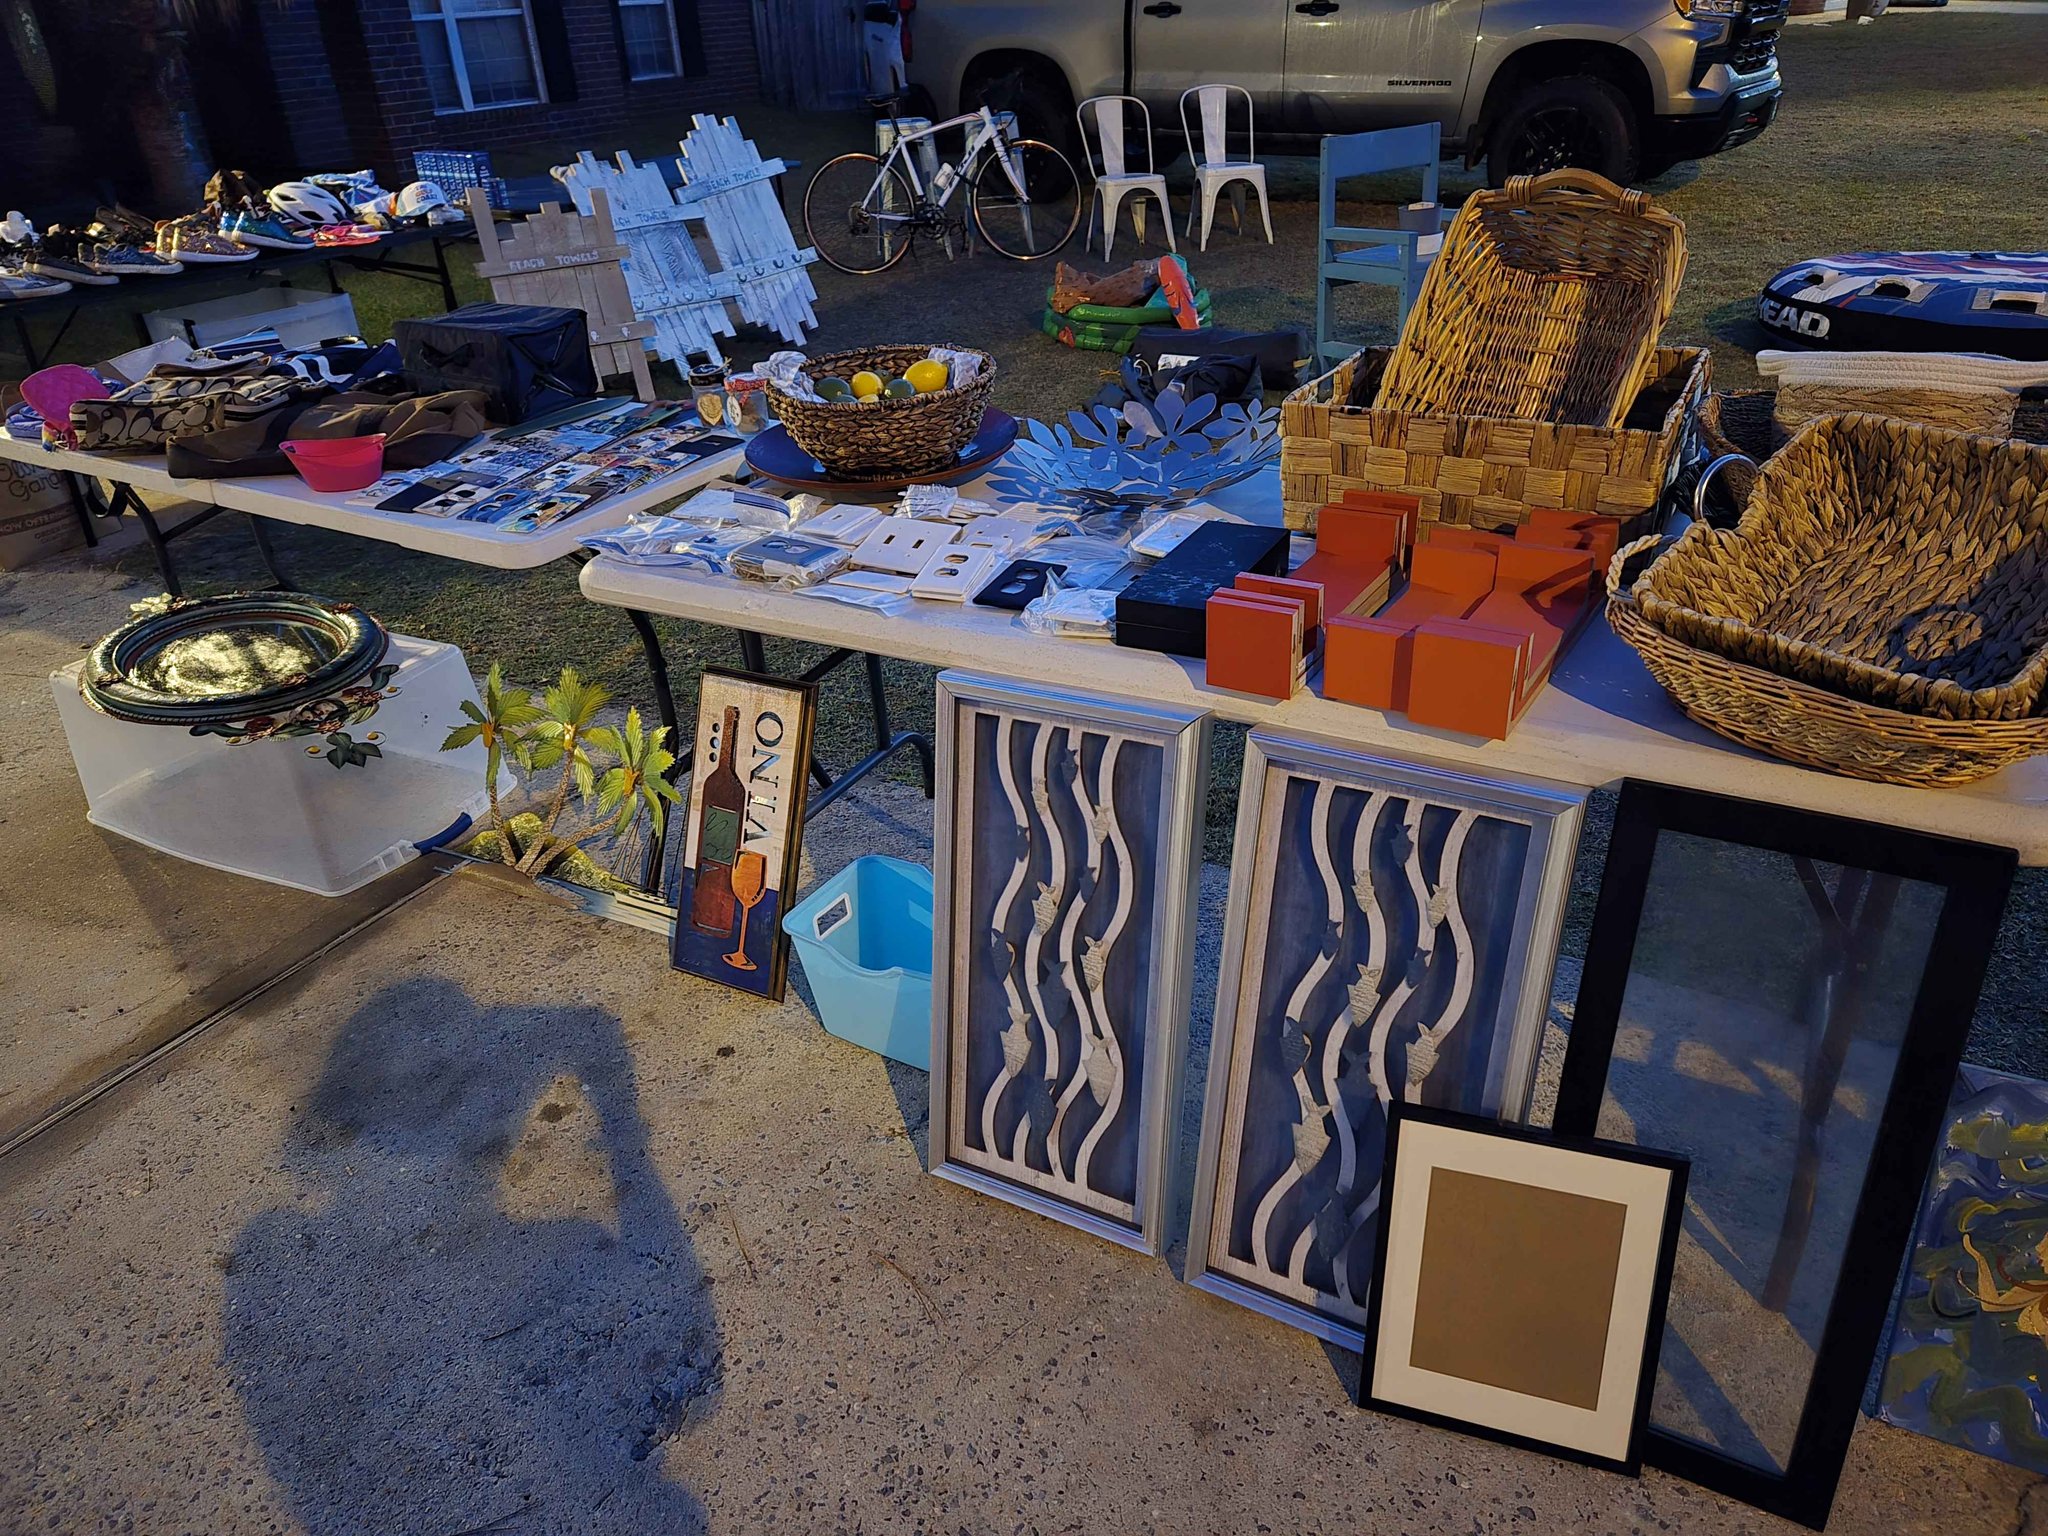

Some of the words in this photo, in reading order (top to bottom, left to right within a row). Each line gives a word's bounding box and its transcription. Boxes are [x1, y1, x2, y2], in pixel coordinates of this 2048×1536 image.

[1387, 79, 1452, 87] SILVERADO
[706, 176, 731, 192] BEACH
[416, 194, 438, 204] COAST
[508, 258, 546, 273] BEACH
[555, 249, 600, 266] TOWELS
[743, 711, 784, 844] VINO
